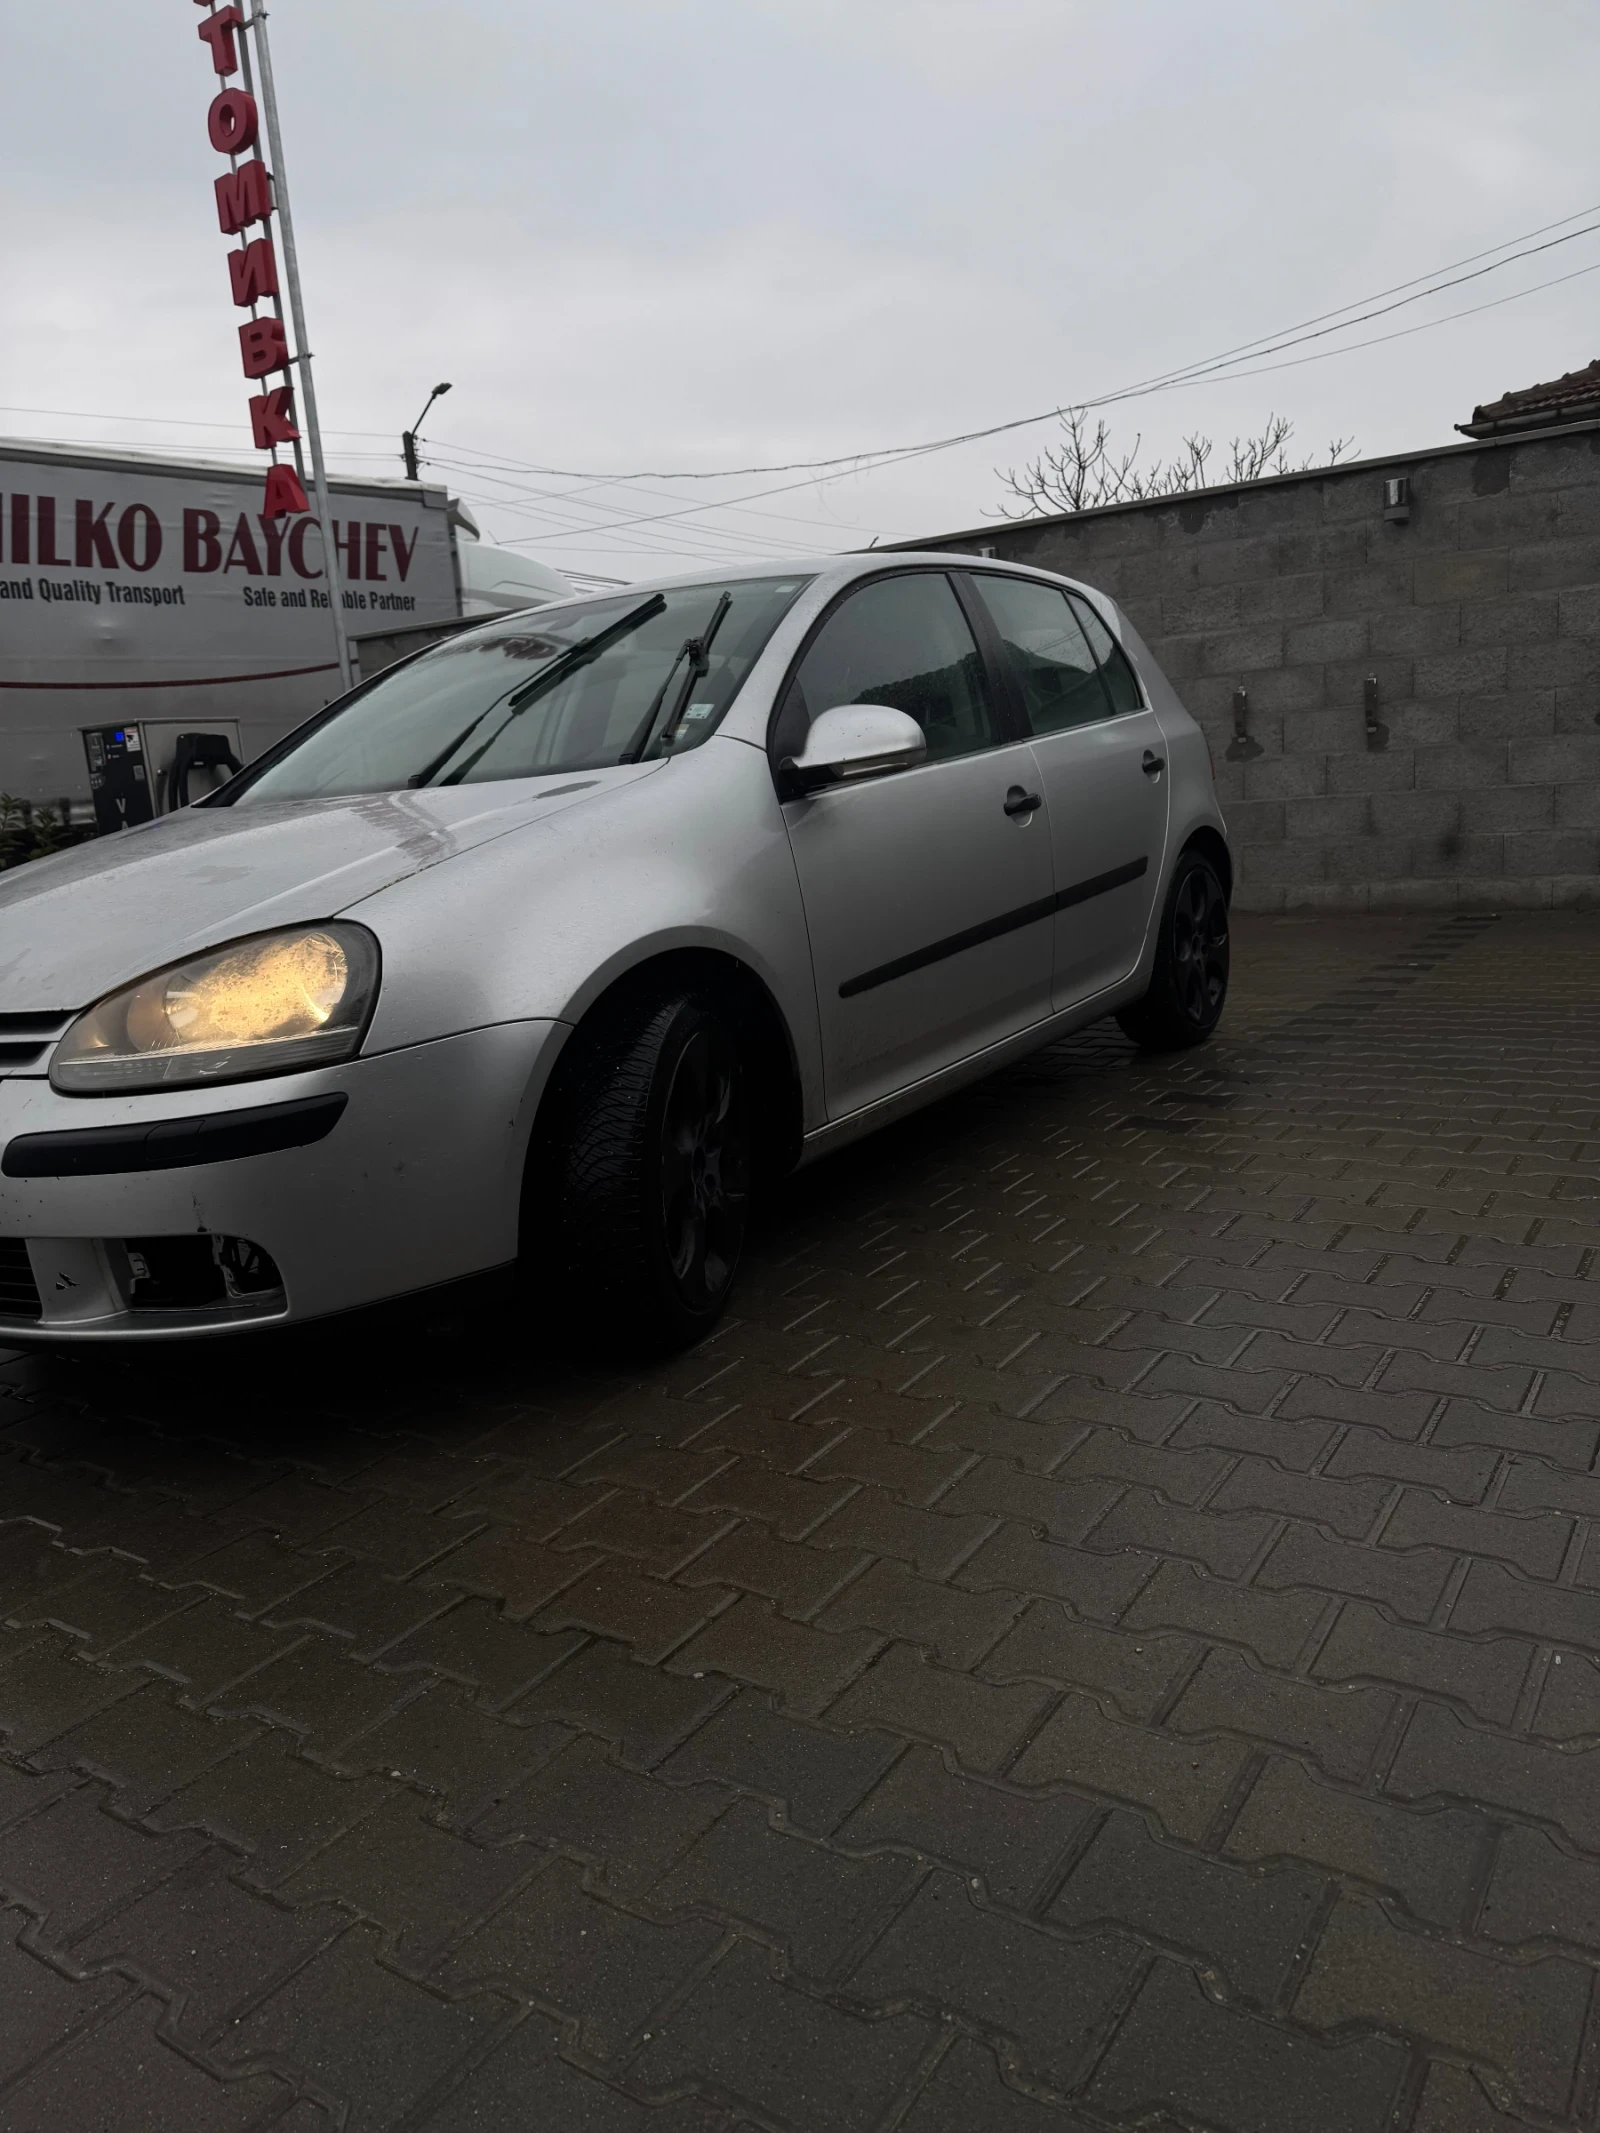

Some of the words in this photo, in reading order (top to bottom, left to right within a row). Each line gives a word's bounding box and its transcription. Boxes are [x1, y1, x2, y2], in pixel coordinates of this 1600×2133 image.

[193, 0, 311, 519] ТОМИВКА
[0, 492, 162, 572] ILKO
[183, 508, 419, 582] BAYCHEV
[0, 578, 33, 600] and
[38, 577, 101, 605] Quality
[105, 581, 186, 606] Transport
[243, 586, 275, 607] Safe
[280, 588, 306, 608] and
[369, 591, 416, 611] Partner
